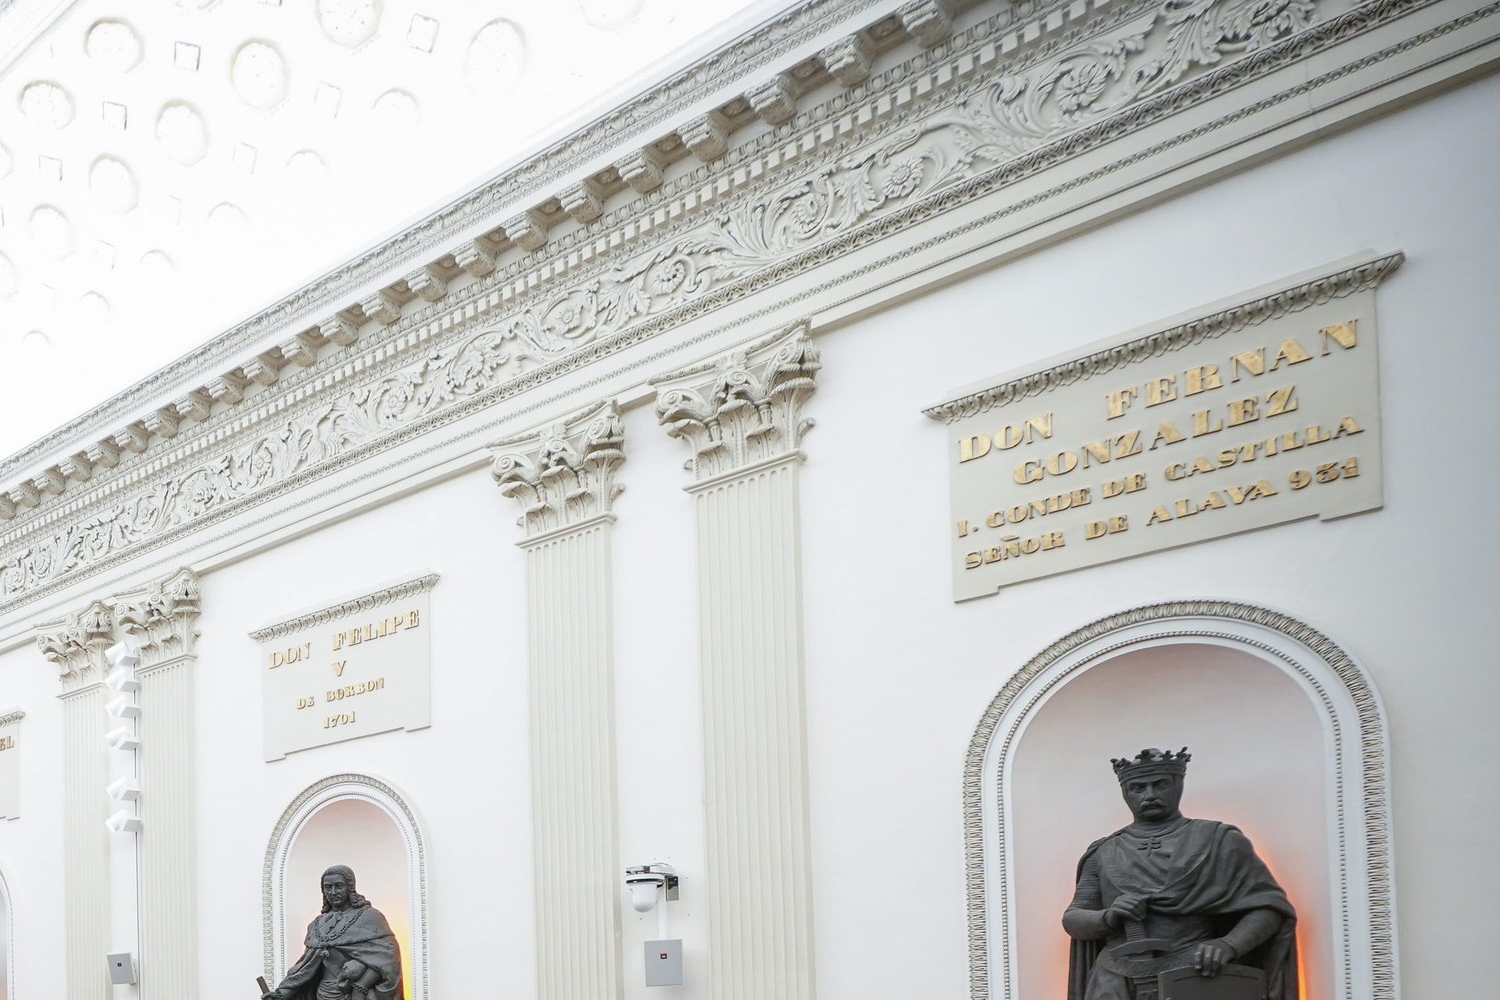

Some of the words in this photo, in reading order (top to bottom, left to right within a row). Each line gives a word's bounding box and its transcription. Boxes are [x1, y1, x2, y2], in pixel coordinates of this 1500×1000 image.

[958, 412, 1054, 463] DON
[1105, 318, 1359, 420] FERNAN
[987, 487, 1092, 528] CONDE
[1102, 472, 1148, 499] DE
[1164, 416, 1364, 481] CASTILLA
[1013, 385, 1299, 485] GONZALEZ
[965, 530, 1066, 569] SEÑOR
[1085, 514, 1128, 541] DE
[1146, 480, 1277, 526] ALAVA
[1289, 457, 1359, 490] 931
[268, 643, 311, 669] DON
[333, 610, 420, 651] FELIPE
[331, 661, 346, 677] V
[297, 696, 315, 710] DE
[326, 678, 384, 702] BORBON
[324, 711, 356, 728] 1701
